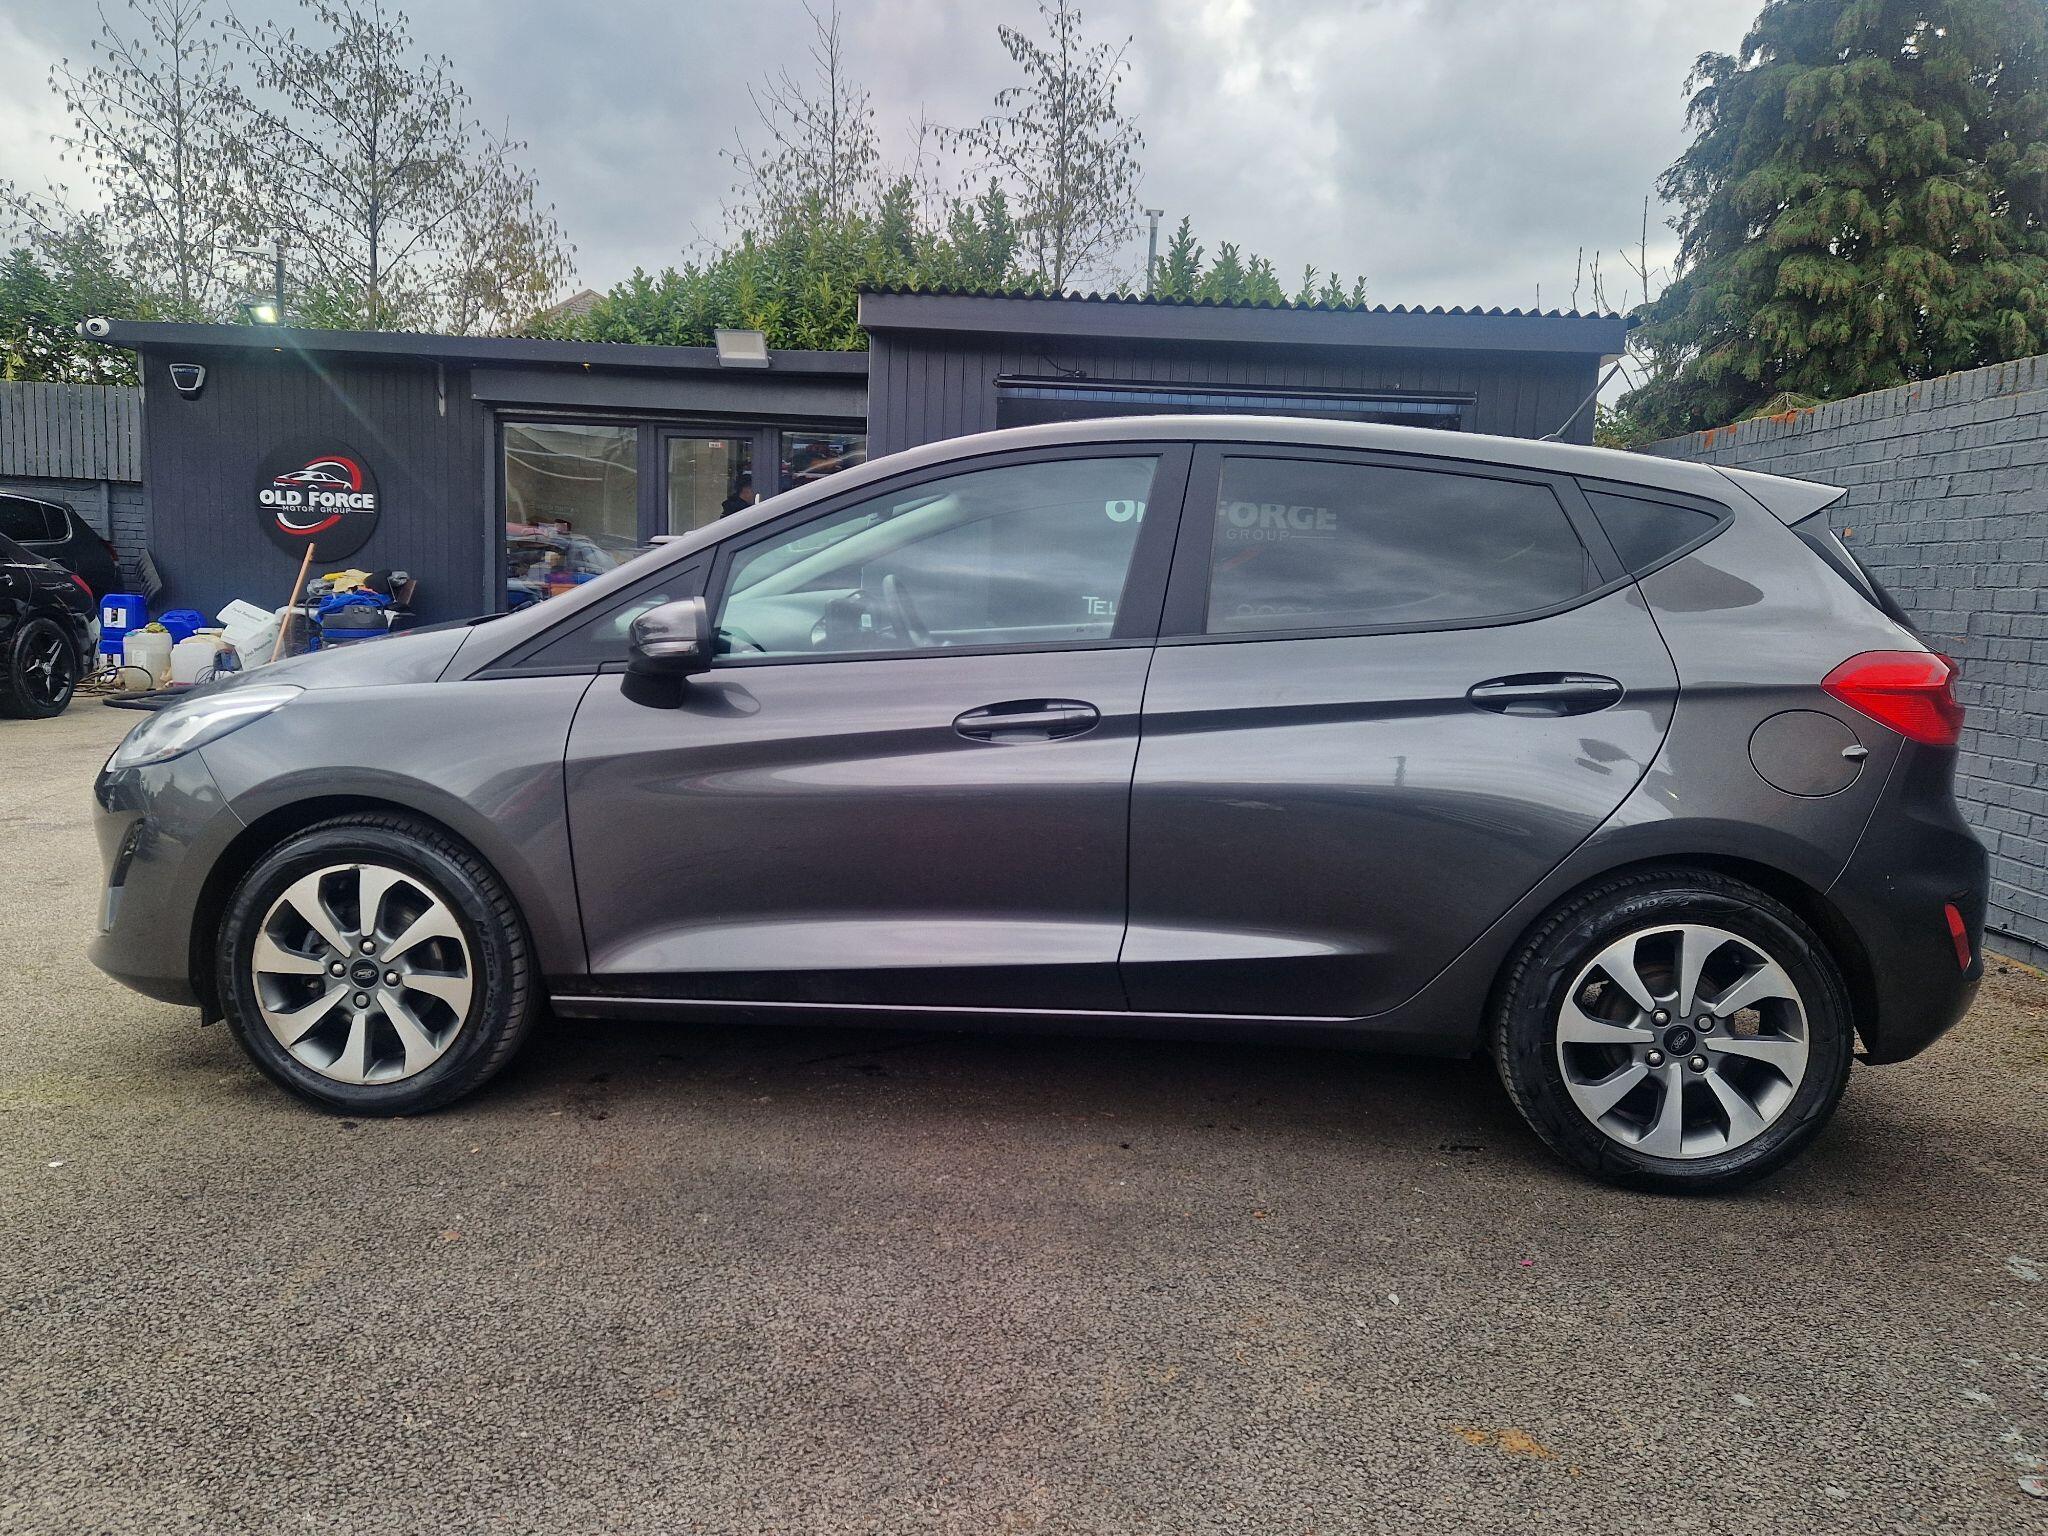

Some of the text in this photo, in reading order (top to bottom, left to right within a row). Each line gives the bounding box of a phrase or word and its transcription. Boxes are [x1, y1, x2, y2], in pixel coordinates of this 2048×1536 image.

[259, 489, 375, 509] OLD FORGE
[282, 505, 352, 514] MOTOR GROUP
[1226, 528, 1291, 542] GROUP
